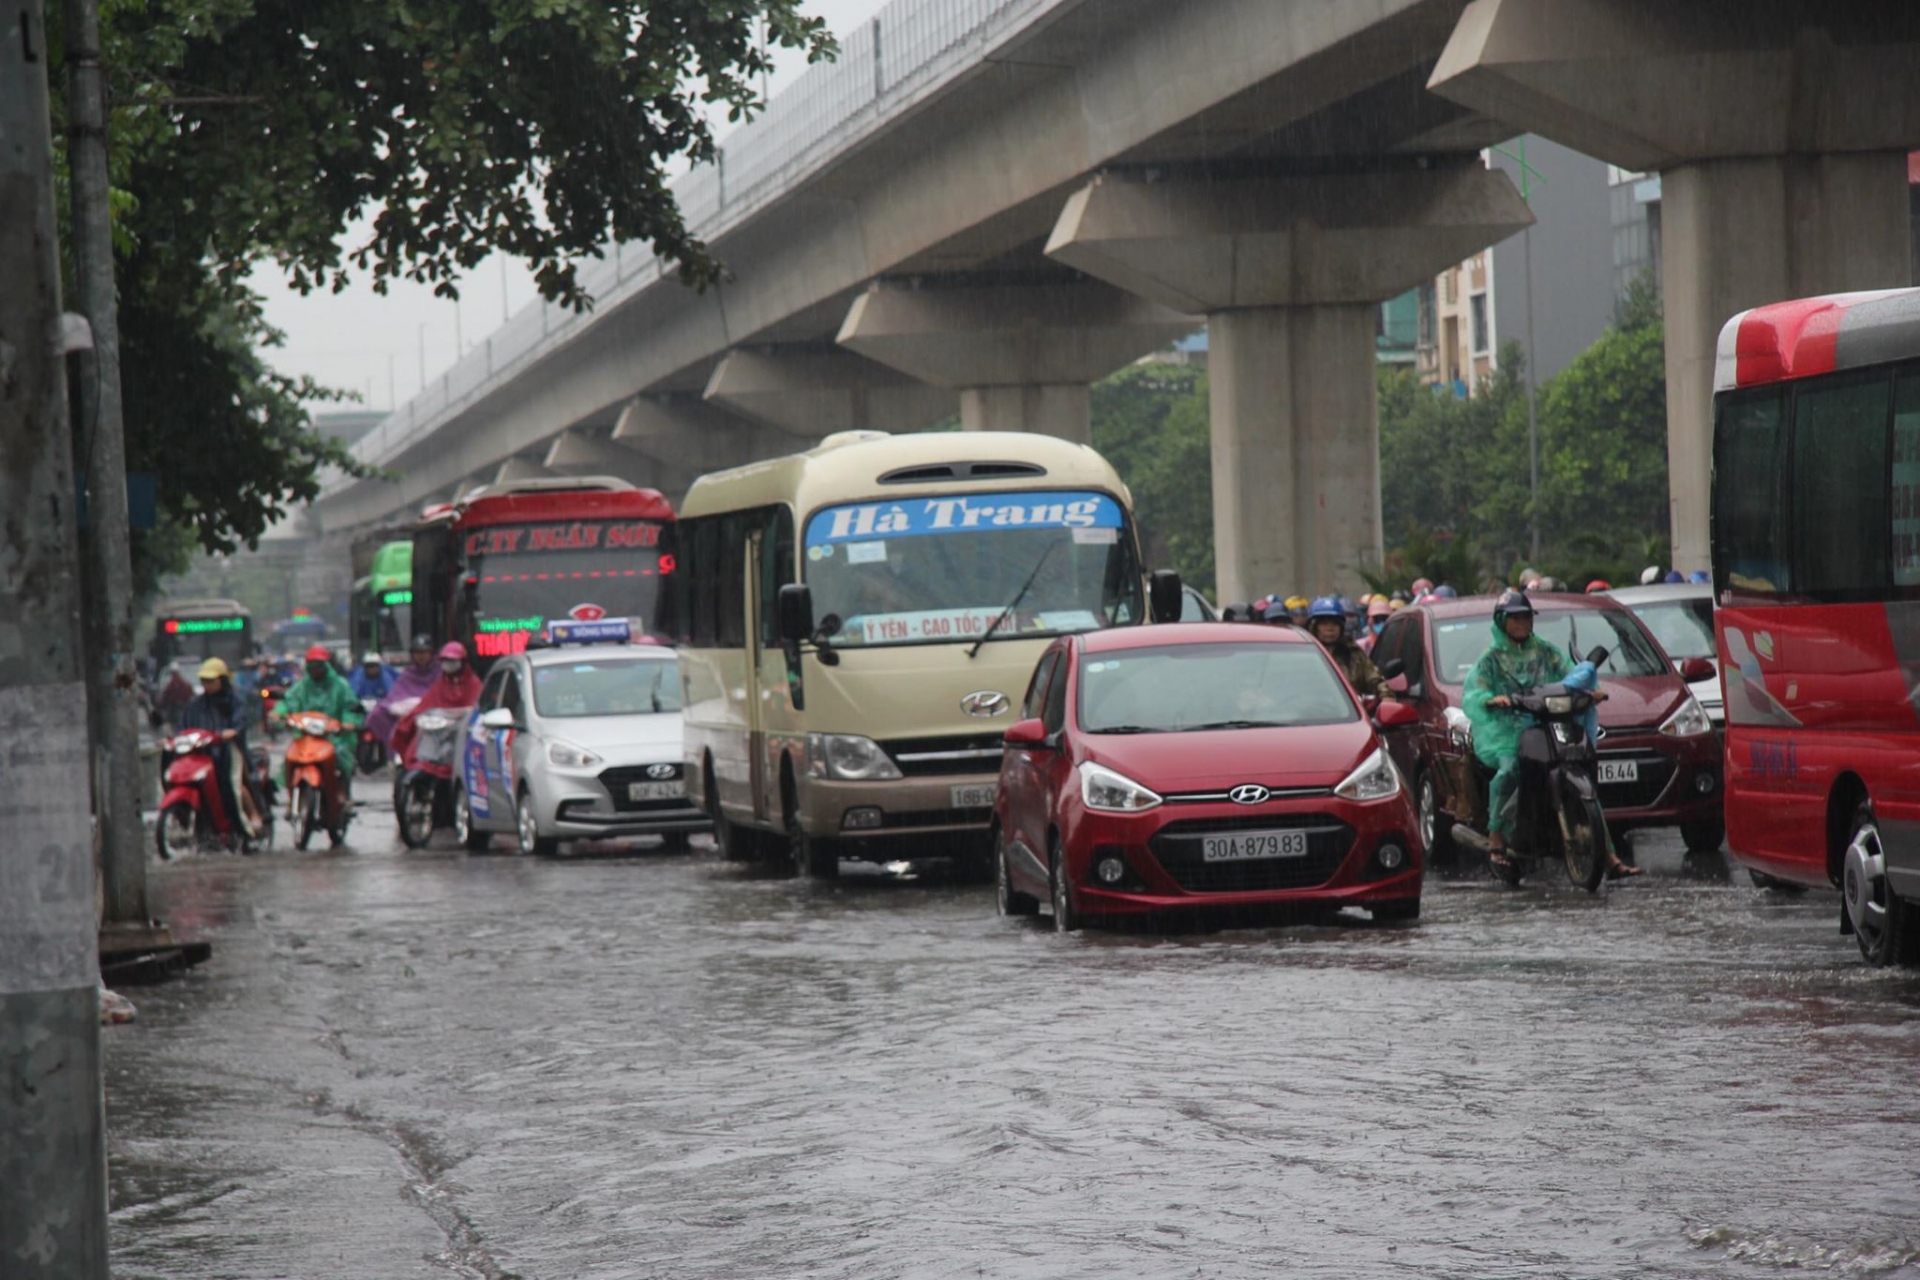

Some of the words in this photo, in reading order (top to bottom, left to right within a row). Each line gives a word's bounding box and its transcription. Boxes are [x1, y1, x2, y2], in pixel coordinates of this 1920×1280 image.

[827, 505, 910, 539] Hà
[924, 497, 1101, 528] Trang
[880, 617, 908, 639] YÊN
[922, 616, 950, 636] CAO
[954, 610, 981, 634] TỐC
[1598, 763, 1635, 781] 16.44
[956, 786, 995, 805] 18B-0
[1205, 834, 1304, 859] 30A-879.83
